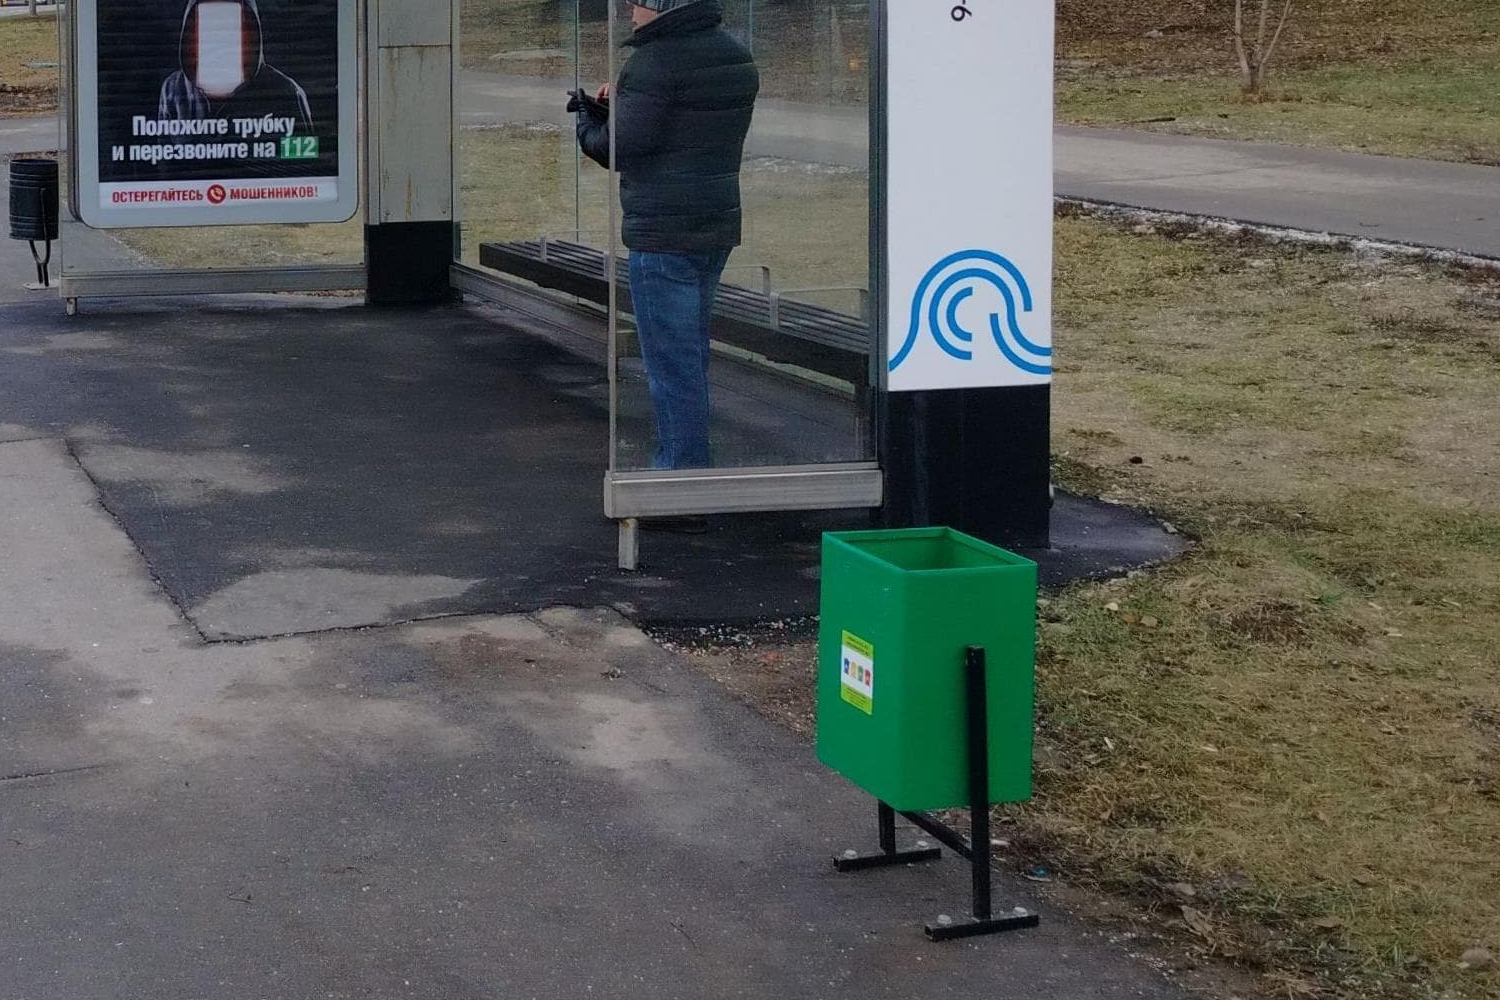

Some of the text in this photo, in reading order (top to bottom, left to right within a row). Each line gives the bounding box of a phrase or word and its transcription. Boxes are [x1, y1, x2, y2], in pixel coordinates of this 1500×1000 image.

[132, 113, 296, 138] Положите трубку
[112, 136, 316, 165] и перезвоните на 112
[112, 186, 318, 203] ОСТЕРЕГАЙТЕСЬ МОШЕННИКОВ!
